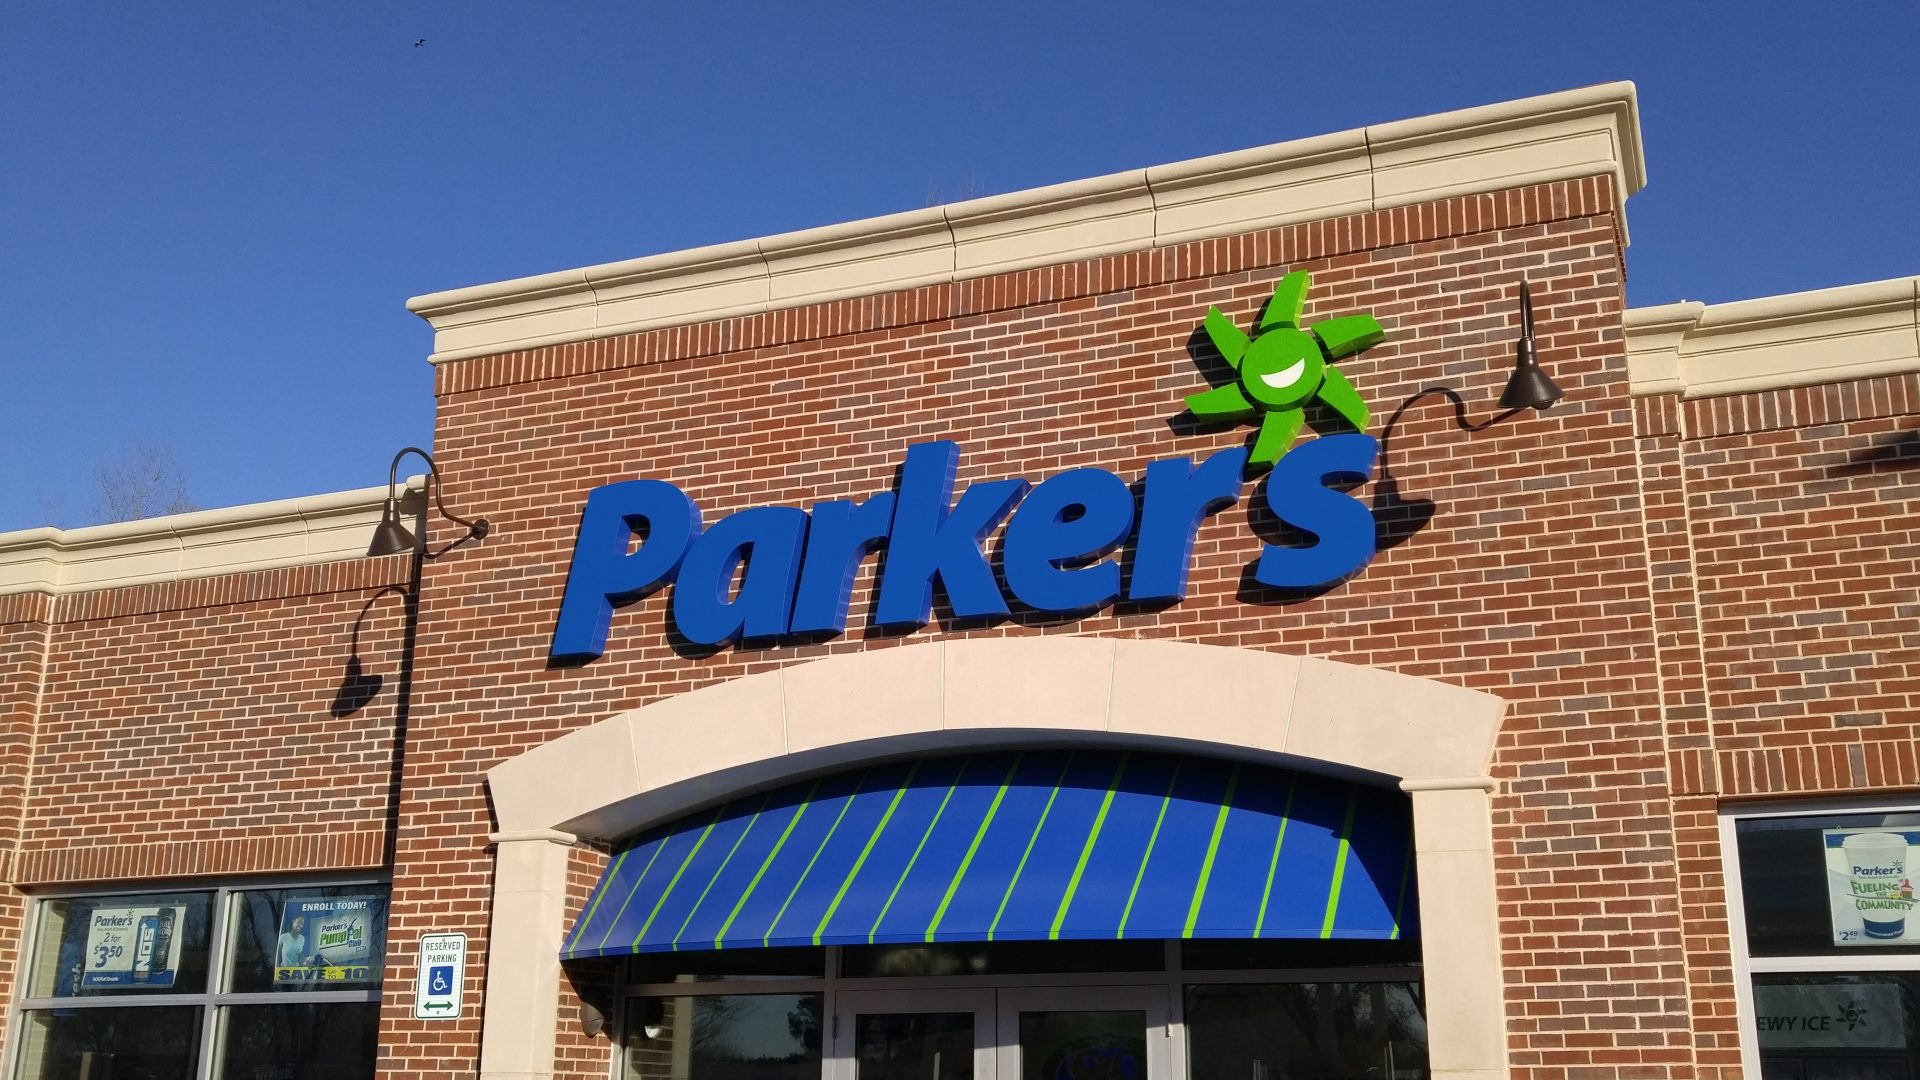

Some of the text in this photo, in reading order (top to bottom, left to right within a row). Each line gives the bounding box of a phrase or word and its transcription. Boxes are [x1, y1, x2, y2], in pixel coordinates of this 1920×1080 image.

[1853, 865, 1904, 875] Parker's
[1850, 880, 1900, 894] FUELING
[302, 901, 367, 912] ENROLL TODAY!
[1855, 898, 1914, 911] COMMUNITY
[94, 914, 133, 927] Parker's
[321, 922, 348, 933] Parker's
[104, 932, 121, 943] 2 for
[135, 922, 155, 971] NOS
[425, 941, 460, 951] RESERVED
[427, 954, 457, 963] PARKING
[278, 969, 325, 980] SAVE
[1801, 1016, 1830, 1031] ICE
